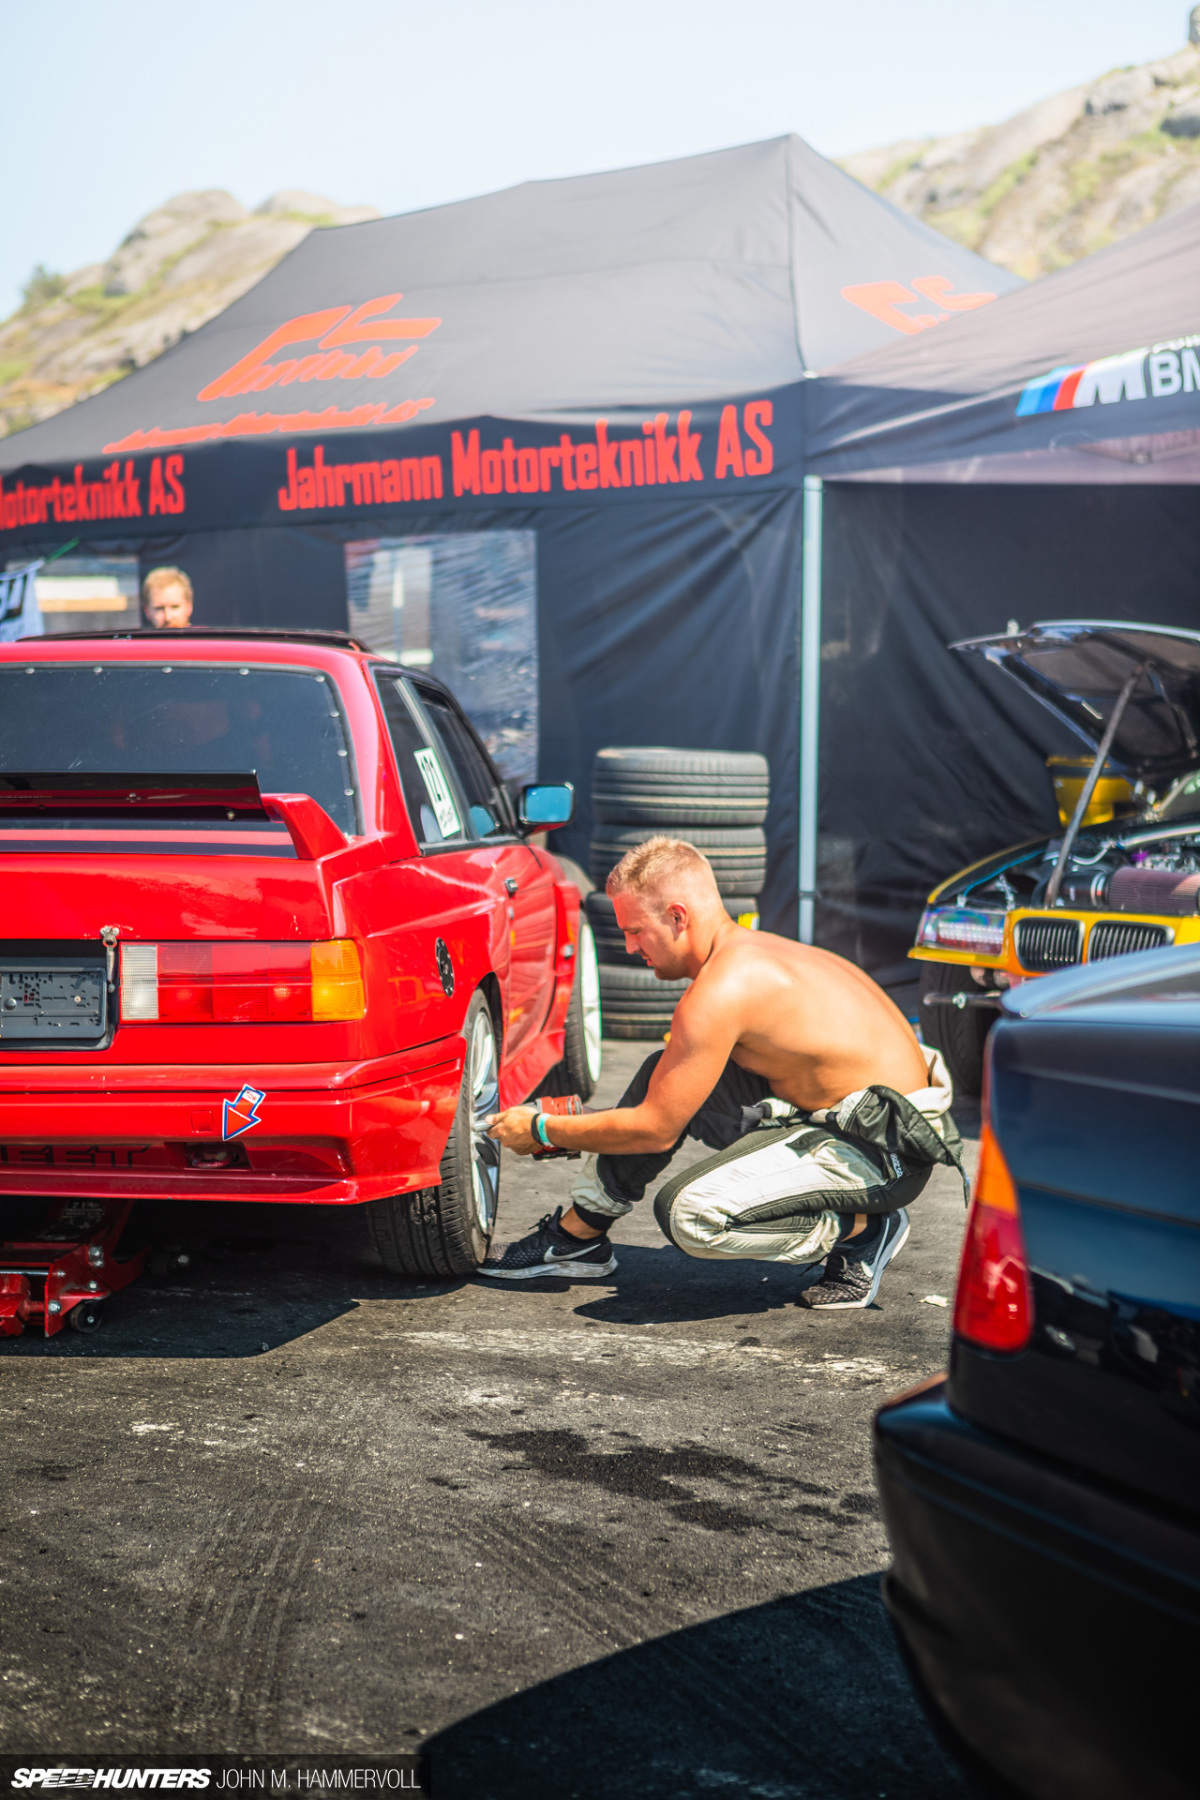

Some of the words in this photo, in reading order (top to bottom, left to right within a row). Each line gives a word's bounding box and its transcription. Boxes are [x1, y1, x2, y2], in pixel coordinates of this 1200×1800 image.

[0, 459, 142, 530] otorteknikk
[148, 453, 185, 516] AS
[278, 446, 442, 510] Jahrmann
[451, 410, 704, 497] Motorteknikk
[715, 400, 773, 479] AS
